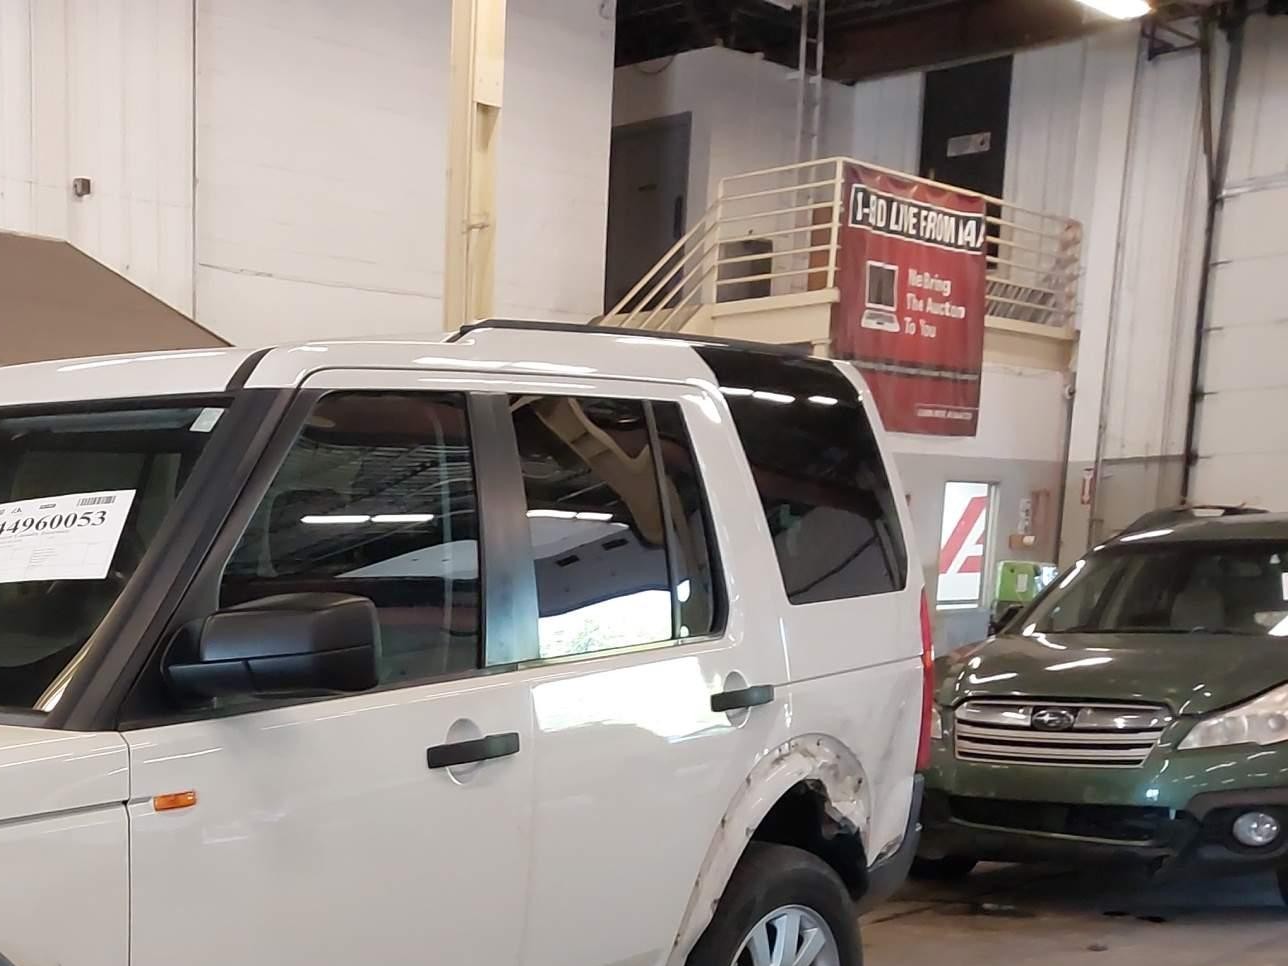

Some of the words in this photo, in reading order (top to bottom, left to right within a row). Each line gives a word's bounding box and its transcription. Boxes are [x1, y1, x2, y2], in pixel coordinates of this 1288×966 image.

[890, 202, 919, 235] LIVE
[920, 209, 955, 243] FROM
[906, 293, 924, 312] The
[904, 316, 916, 335] To
[919, 318, 937, 338] You
